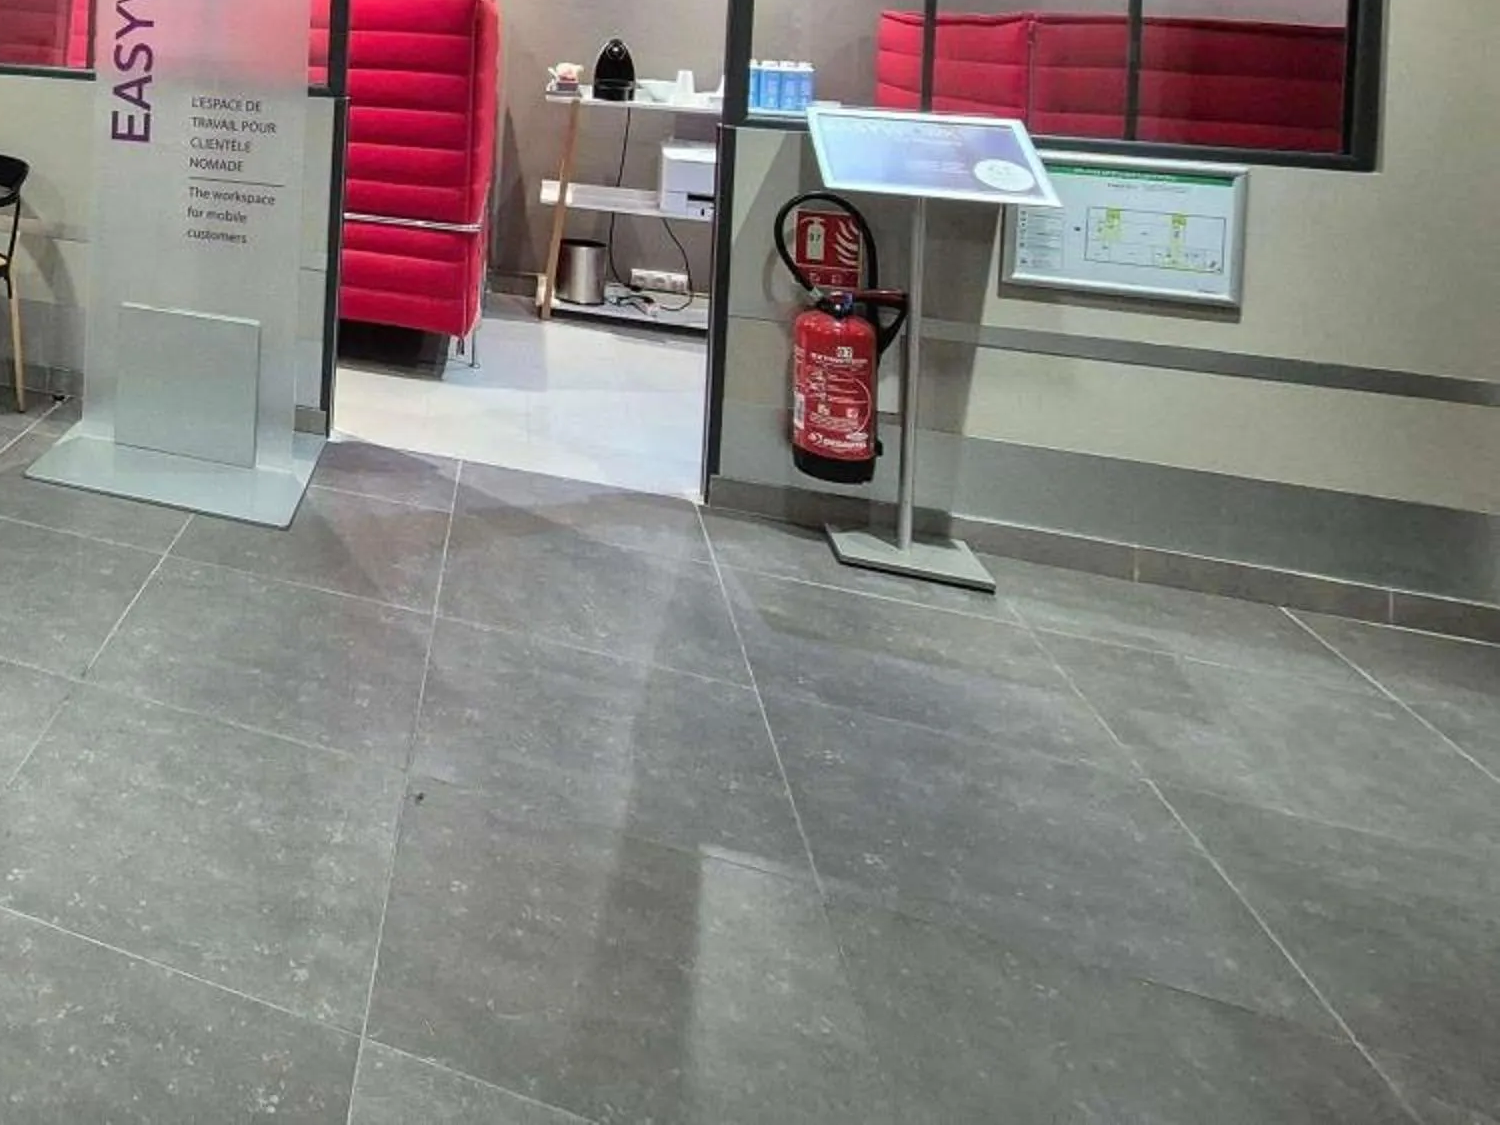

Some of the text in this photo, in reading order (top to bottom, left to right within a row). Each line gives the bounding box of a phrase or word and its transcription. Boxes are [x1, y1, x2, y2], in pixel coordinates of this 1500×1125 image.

[191, 96, 262, 113] L'ESPACE DE
[190, 116, 277, 134] TRAVAIL POUR
[188, 157, 245, 172] NOMADE
[188, 186, 276, 206] The workspace
[187, 205, 248, 224] for mobile
[187, 228, 248, 244] customers
